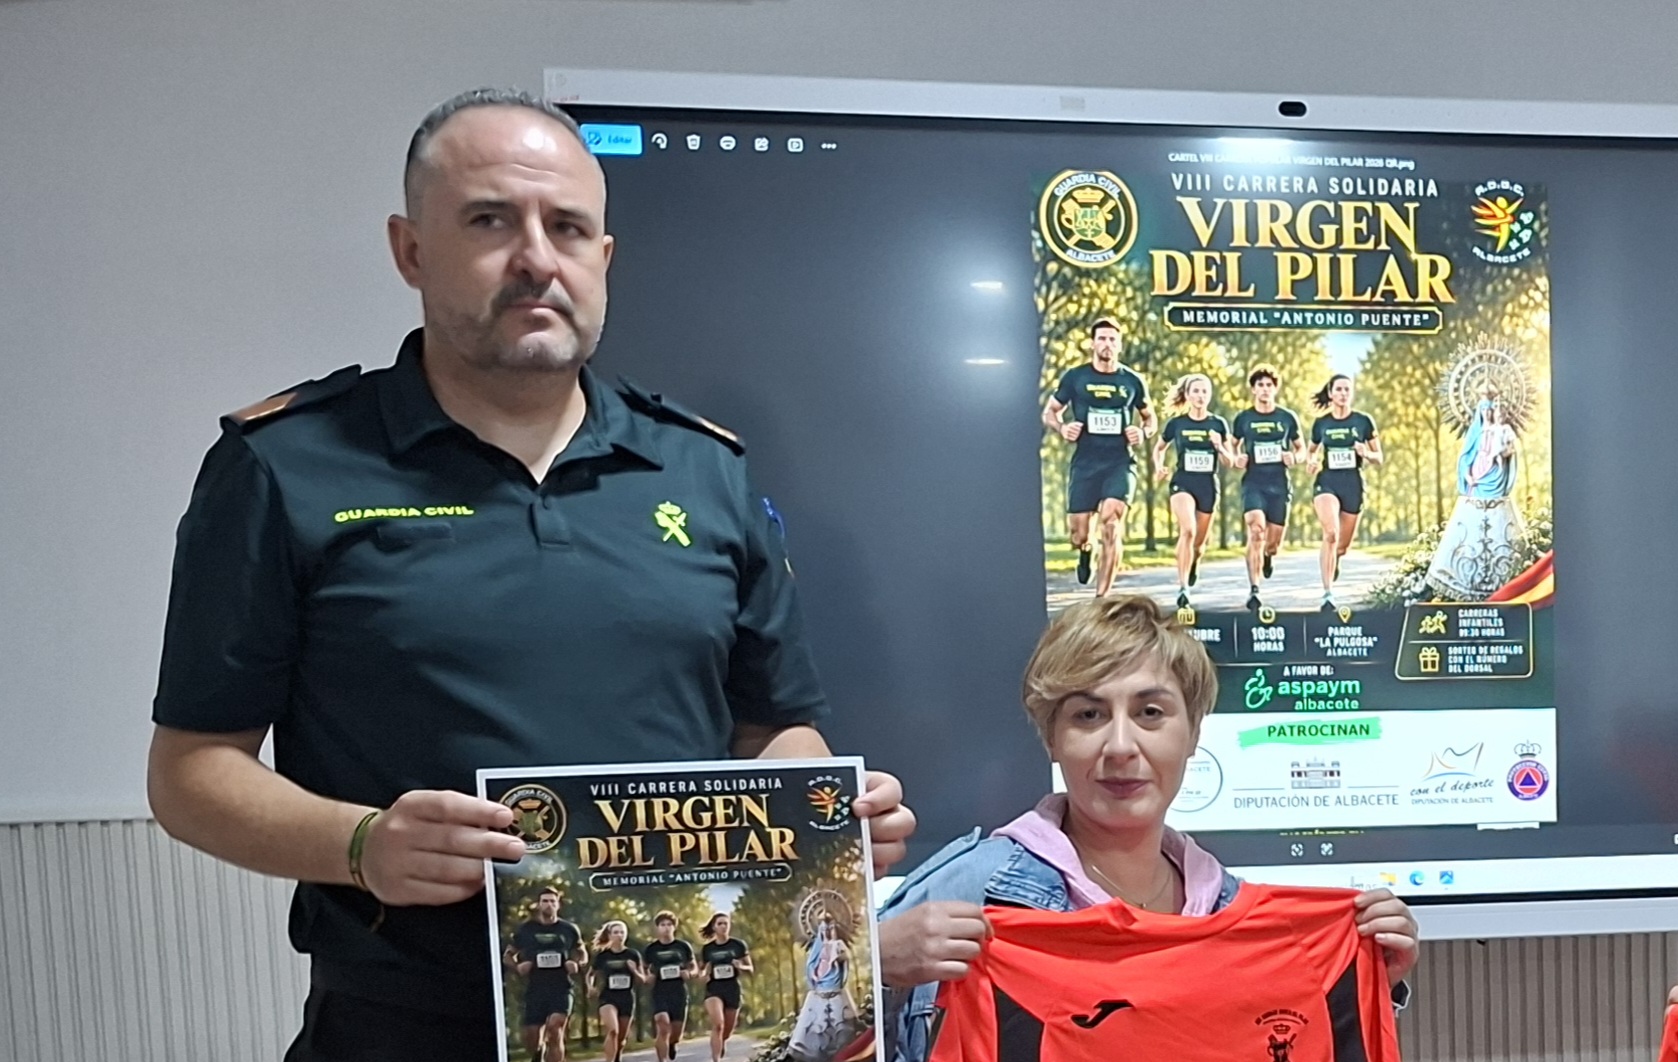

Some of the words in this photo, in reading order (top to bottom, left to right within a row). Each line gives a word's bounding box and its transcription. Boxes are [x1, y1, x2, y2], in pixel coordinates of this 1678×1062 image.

[1171, 173, 1211, 191] VIII
[1223, 174, 1318, 193] CARRERA
[1329, 177, 1438, 197] SOLIDARIA
[1176, 196, 1420, 252] VIRGEN
[1151, 250, 1255, 298] DEL
[1273, 251, 1456, 304] PILAR
[1183, 310, 1268, 325] MEMORIAL
[1093, 415, 1117, 427] 1153
[334, 506, 421, 523] GUARDIA
[424, 505, 475, 517] CIVIL
[1251, 626, 1285, 640] 10:00
[1328, 626, 1362, 636] PARQUE
[1253, 642, 1285, 652] HORAS
[1326, 648, 1368, 656] ALBACETE
[1283, 666, 1291, 676] A
[1292, 666, 1318, 676] FAVOR
[1277, 679, 1361, 697] aspaym
[1294, 697, 1360, 711] albacete
[1267, 724, 1370, 737] PATROCINAN
[590, 784, 619, 796] VIII
[628, 780, 697, 795] CARRERA
[704, 777, 783, 792] SOLIDARIA
[1233, 793, 1311, 809] DIPUTACIÓN
[1313, 795, 1330, 808] DE
[1334, 793, 1399, 808] ALBACETE
[594, 793, 770, 834] VIRGEN
[575, 834, 655, 869] DEL
[666, 826, 800, 867] PILAR
[602, 874, 665, 887] MEMORIAL
